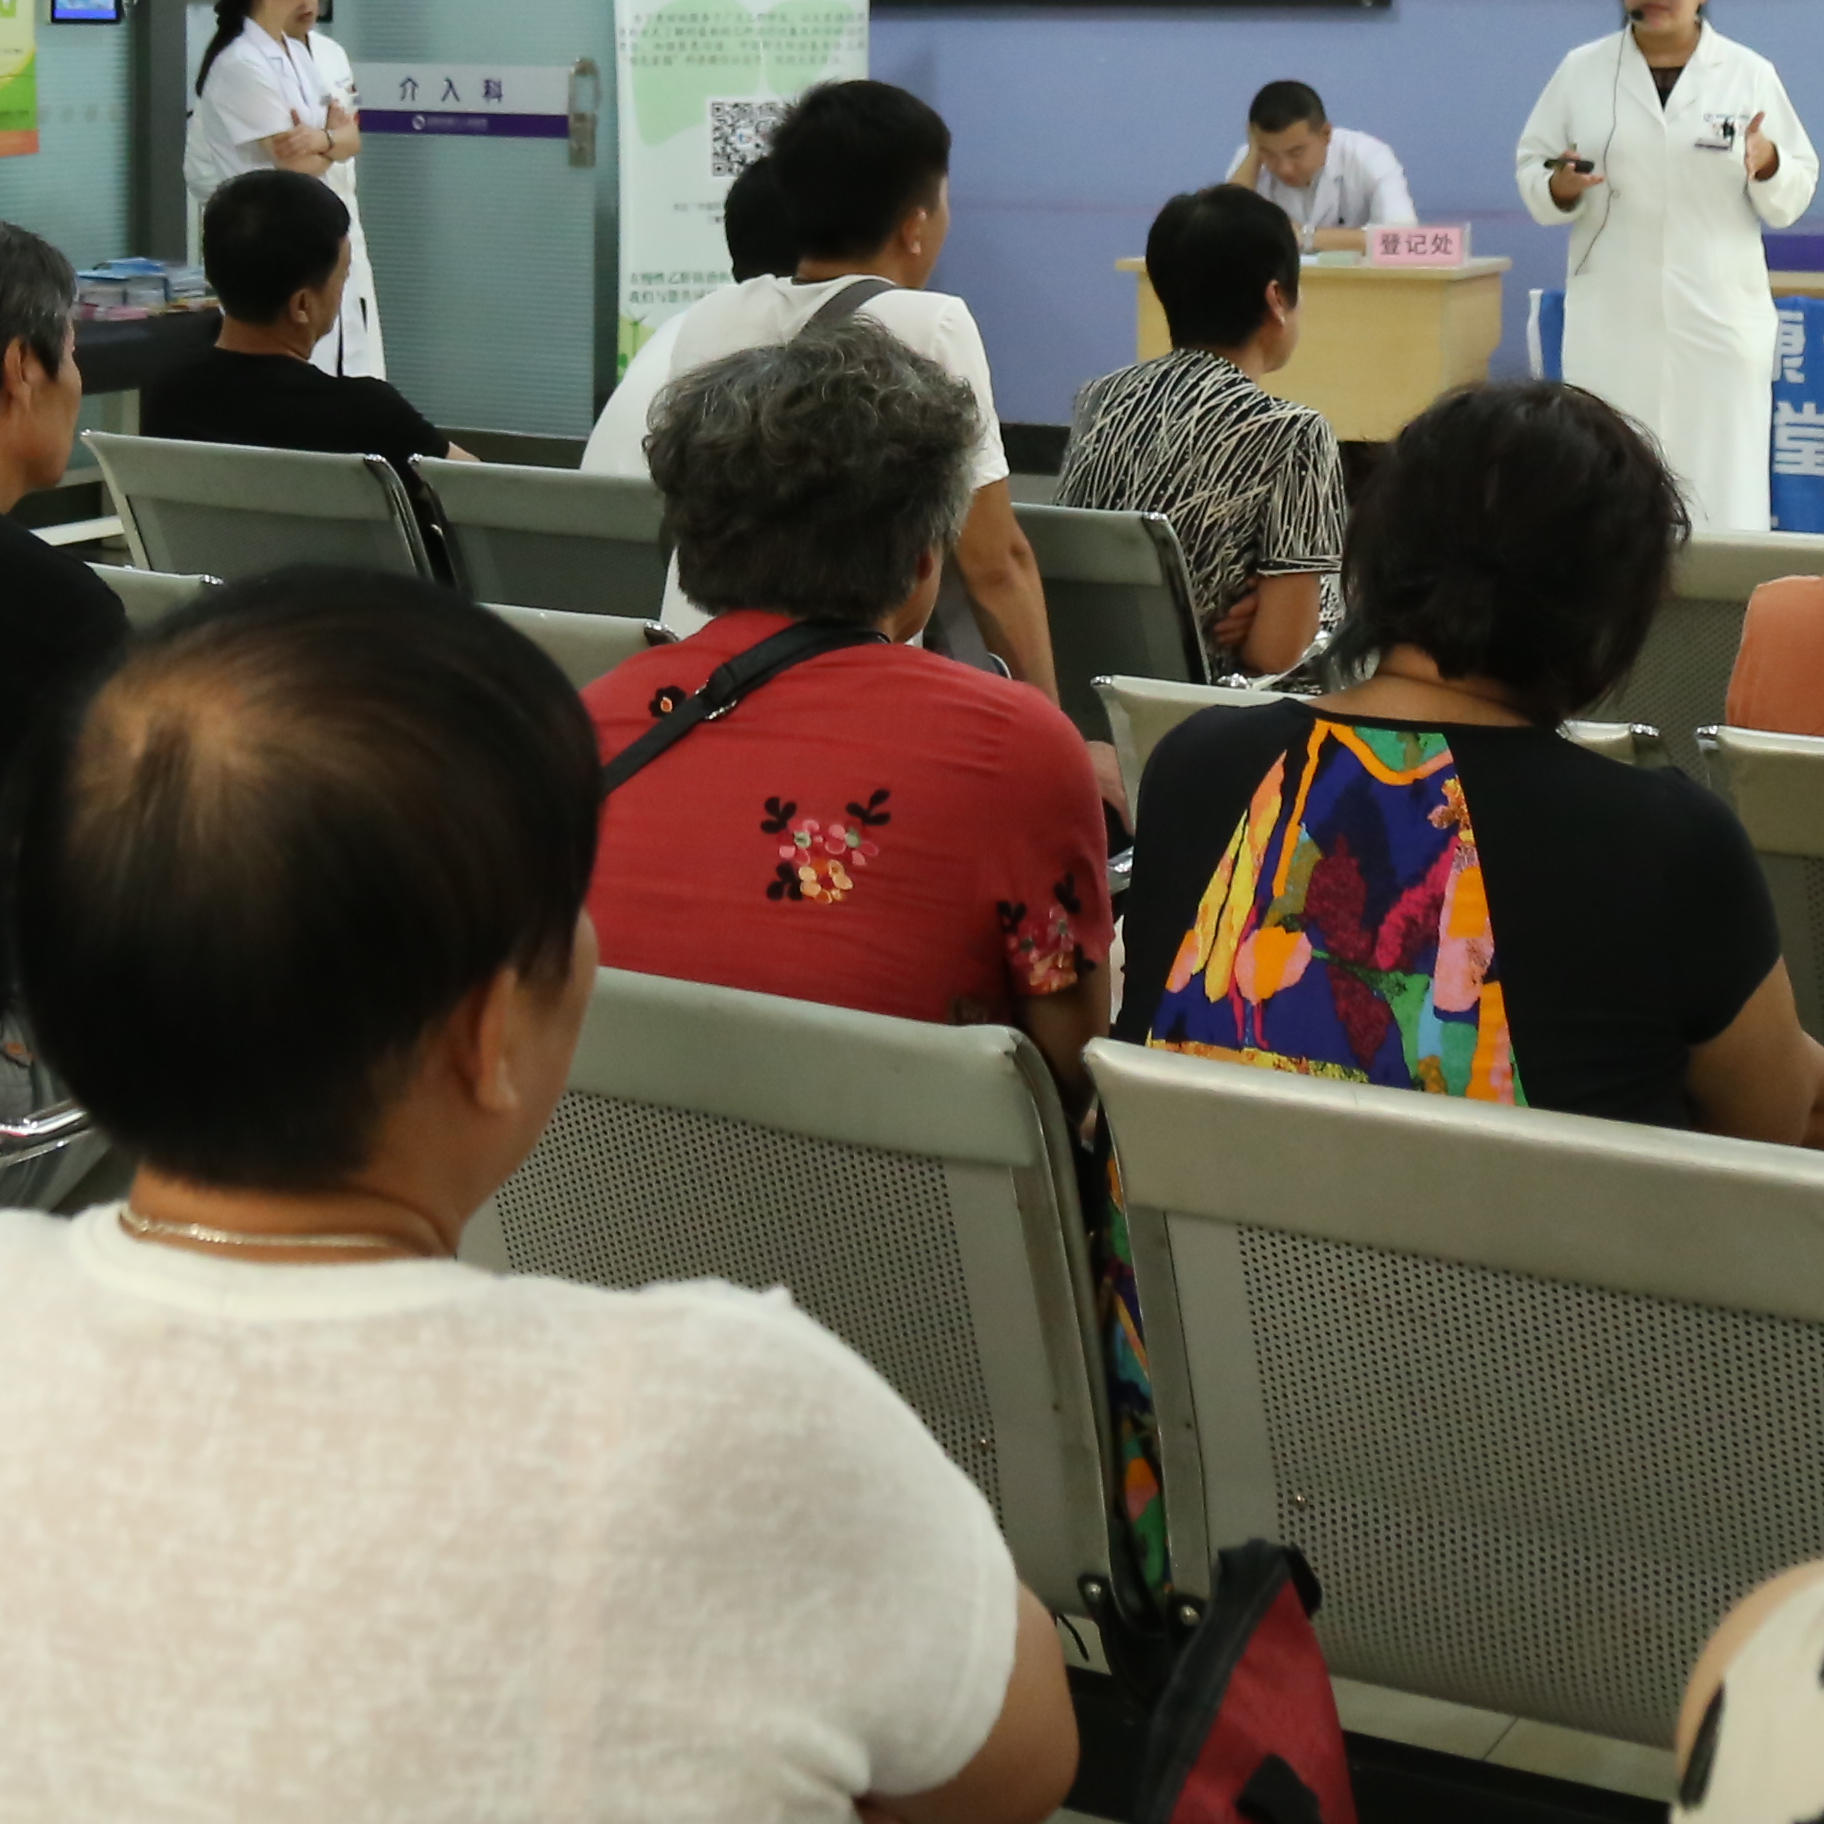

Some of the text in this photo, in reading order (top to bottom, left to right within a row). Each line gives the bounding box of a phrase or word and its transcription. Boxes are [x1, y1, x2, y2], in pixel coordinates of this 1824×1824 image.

[398, 76, 504, 103] 介入科
[1380, 233, 1453, 256] 登记处
